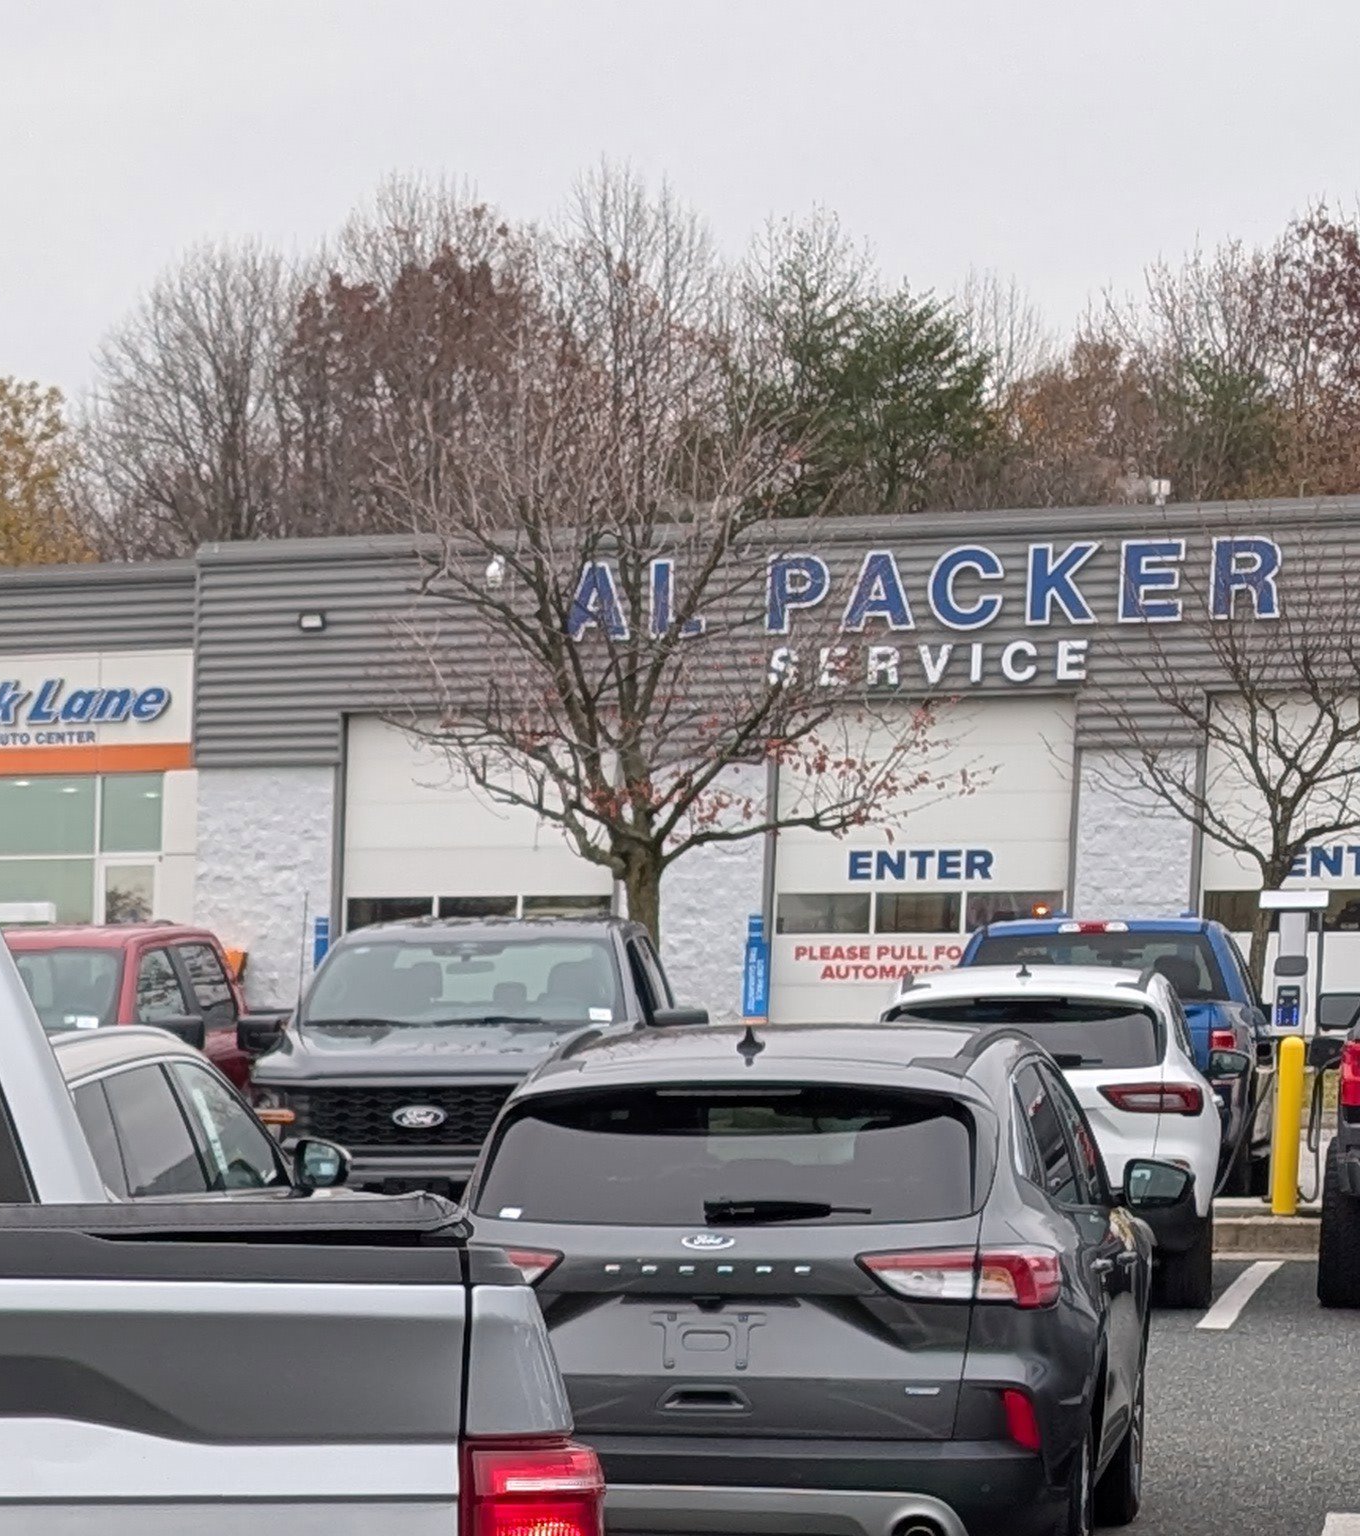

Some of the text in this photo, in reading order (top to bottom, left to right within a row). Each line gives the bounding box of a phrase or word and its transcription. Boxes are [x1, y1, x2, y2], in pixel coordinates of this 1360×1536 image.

[568, 535, 1283, 642] AL PACKER
[769, 638, 1088, 689] SERVICE
[27, 678, 172, 726] Lane
[35, 730, 96, 745] CENTER
[847, 849, 994, 881] ENTER
[794, 945, 871, 961] PLEASE
[876, 945, 928, 961] PULL
